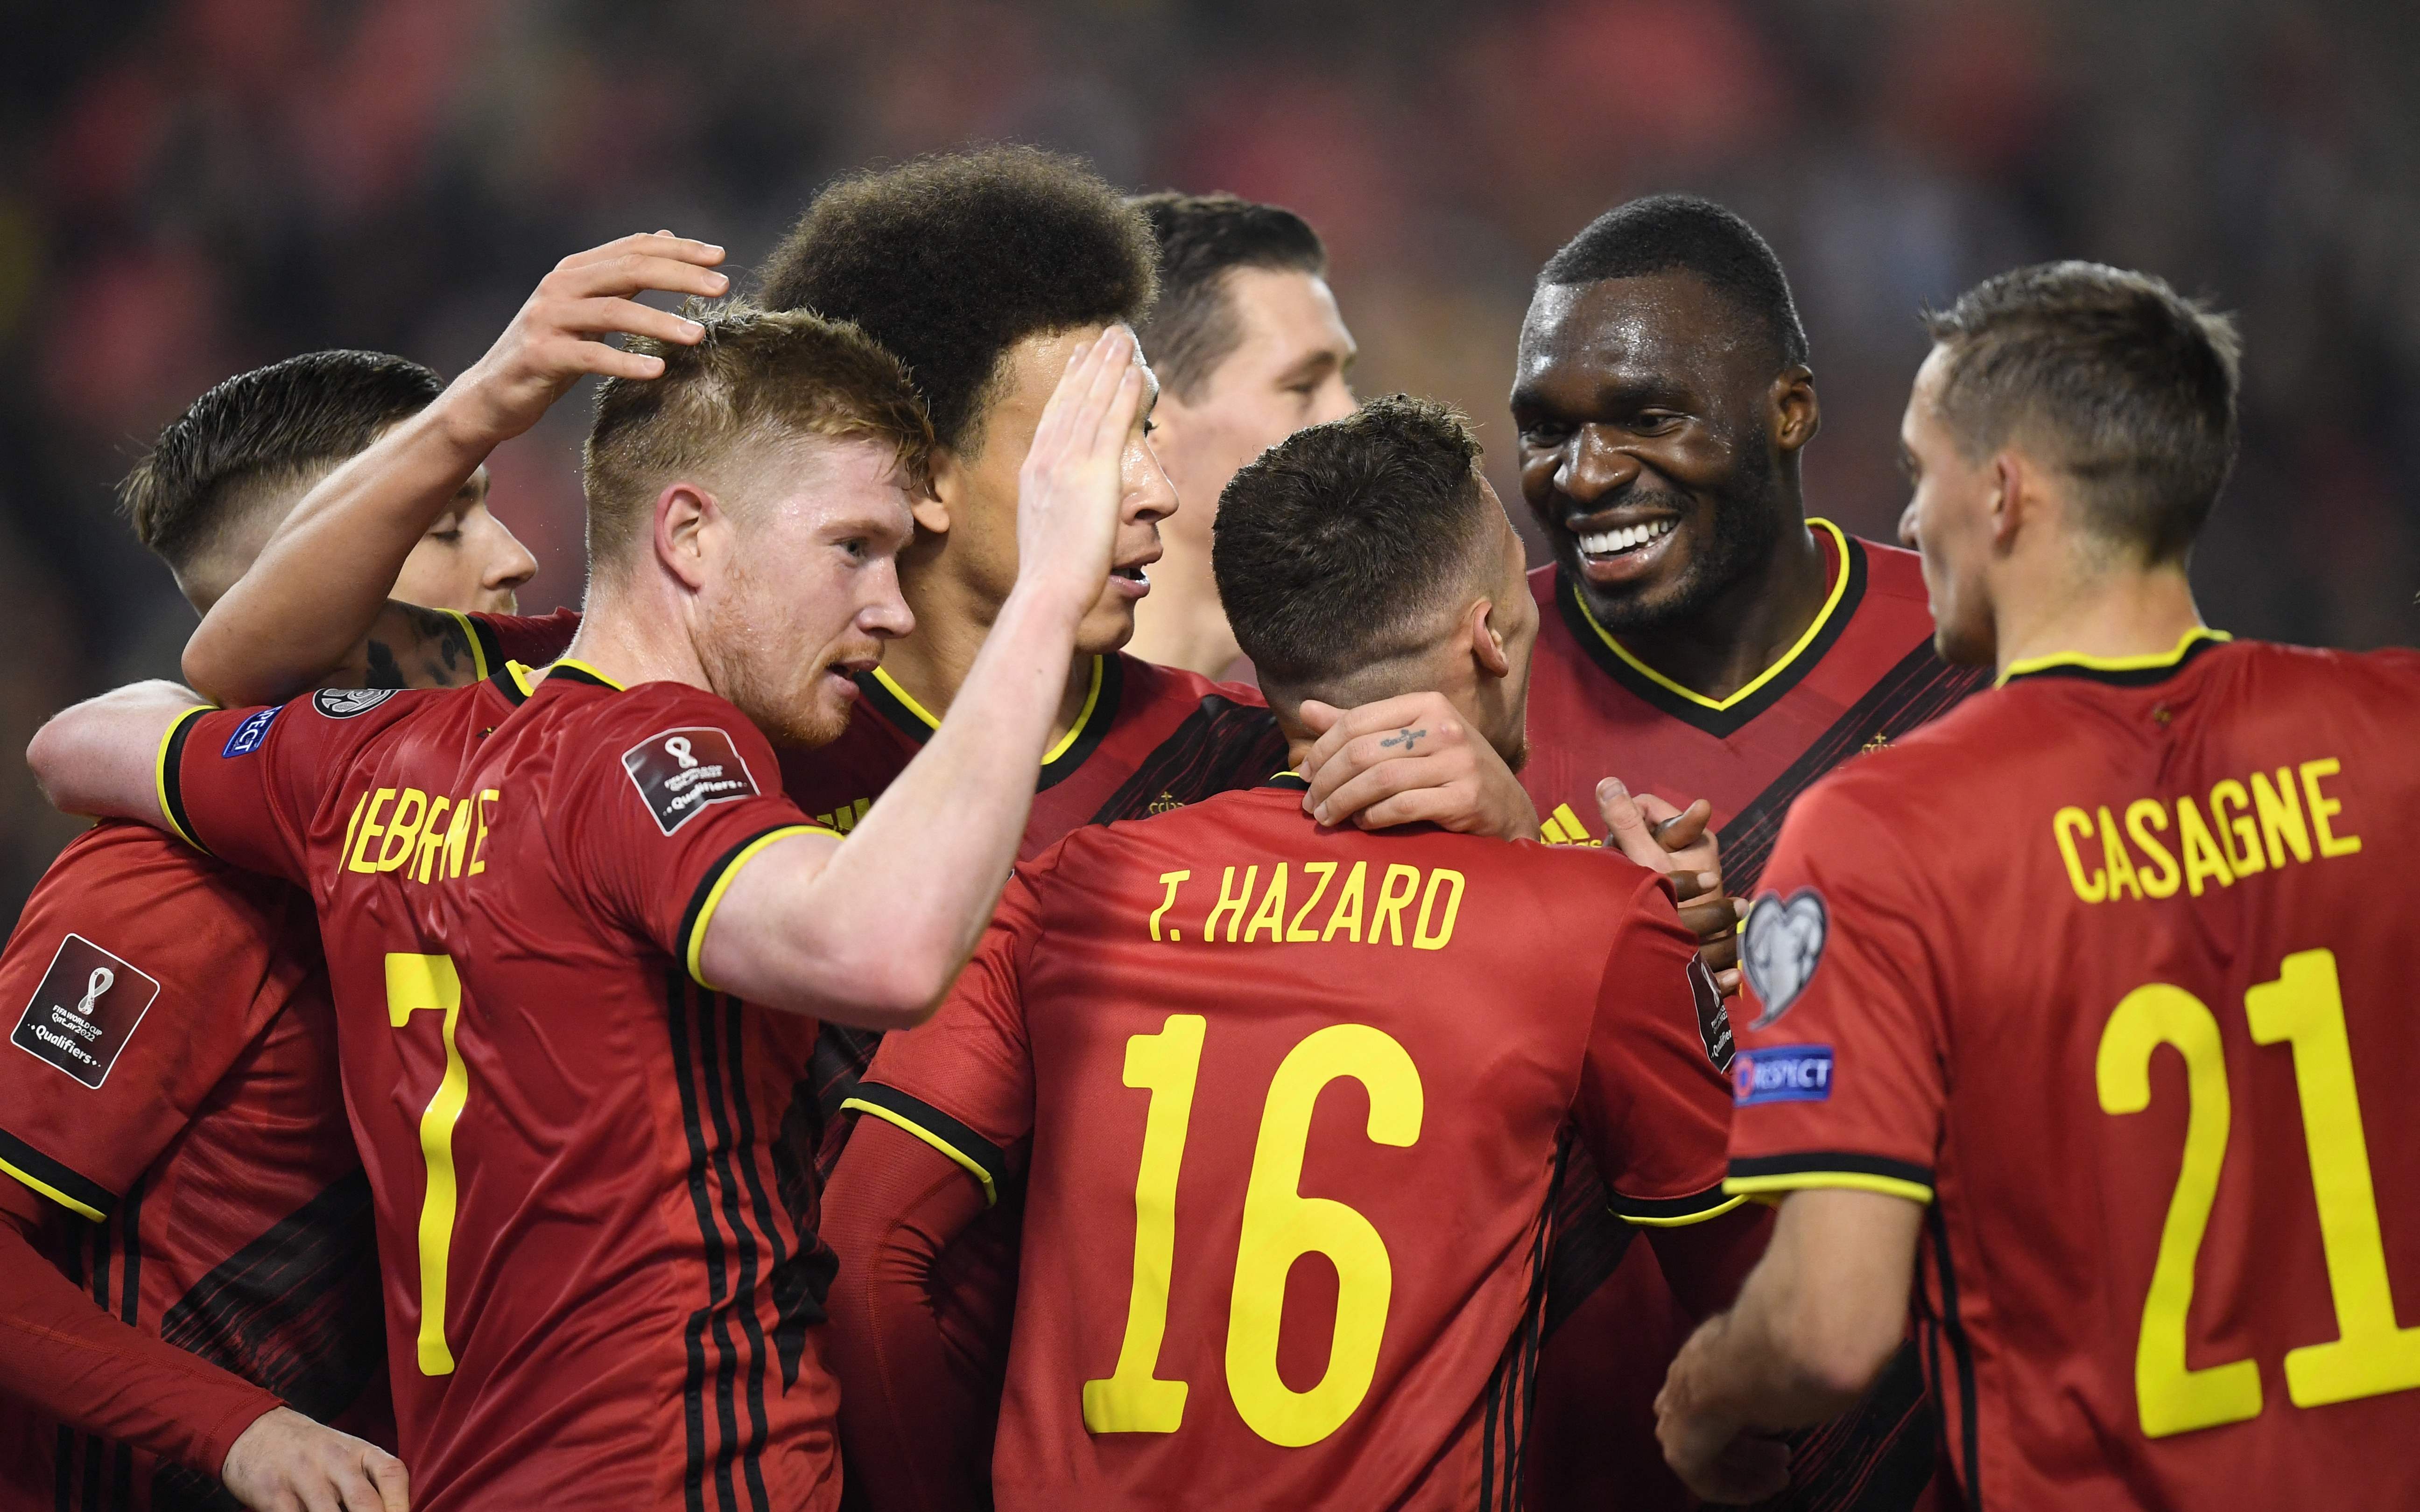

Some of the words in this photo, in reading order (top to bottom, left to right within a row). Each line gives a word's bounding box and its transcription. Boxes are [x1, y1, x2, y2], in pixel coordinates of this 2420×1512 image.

[53, 1005, 67, 1016] FIFA
[66, 1012, 90, 1029] WORLD
[90, 1024, 103, 1036] CUP
[1149, 870, 1190, 942] T.
[1203, 861, 1466, 950] HAZARD
[36, 1025, 92, 1064] Qualifiers
[384, 952, 469, 1377] 7
[1082, 1014, 1424, 1448] 16
[2095, 948, 2420, 1439] 21
